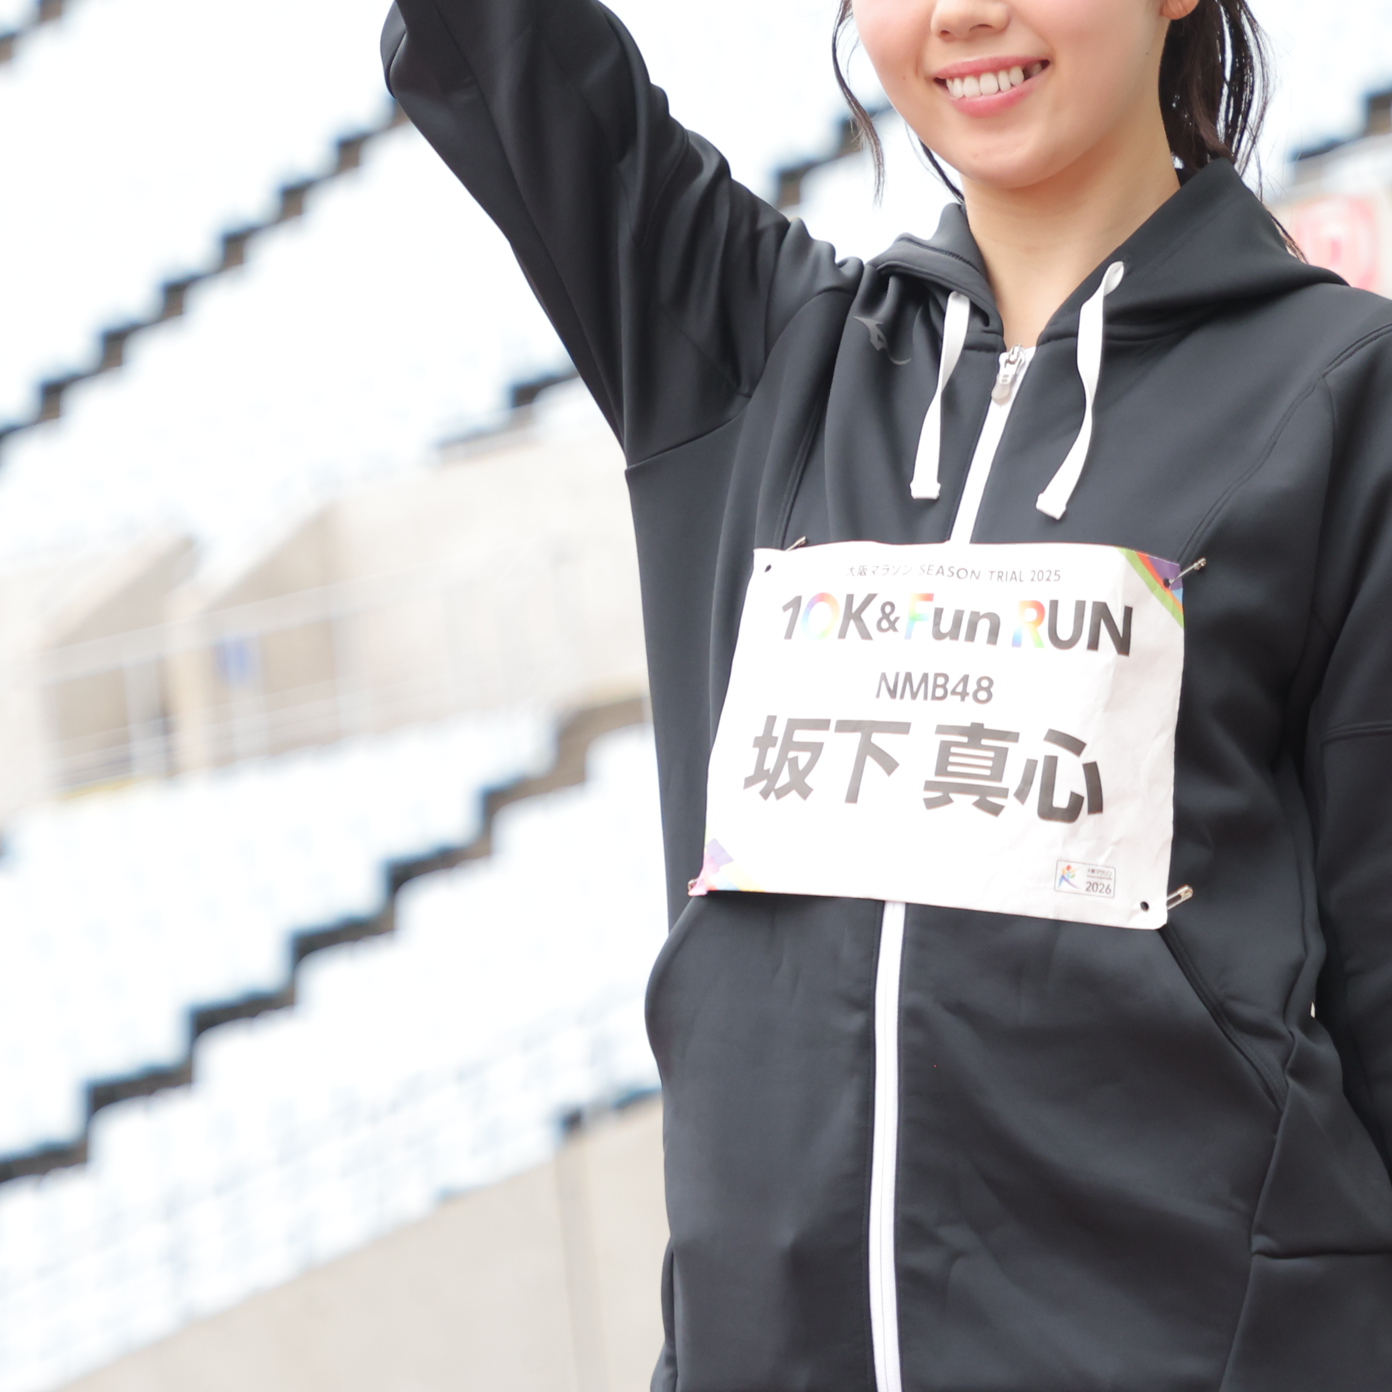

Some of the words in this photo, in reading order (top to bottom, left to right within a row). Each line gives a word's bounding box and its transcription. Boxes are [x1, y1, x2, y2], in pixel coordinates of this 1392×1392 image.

[845, 564, 914, 578] 大阪マラソン
[918, 564, 981, 581] SEASON
[988, 570, 1024, 583] TRIAL
[1030, 569, 1061, 583] 2025
[1011, 599, 1133, 658] RUN
[876, 671, 995, 705] NMB48
[1085, 881, 1112, 895] 2026
